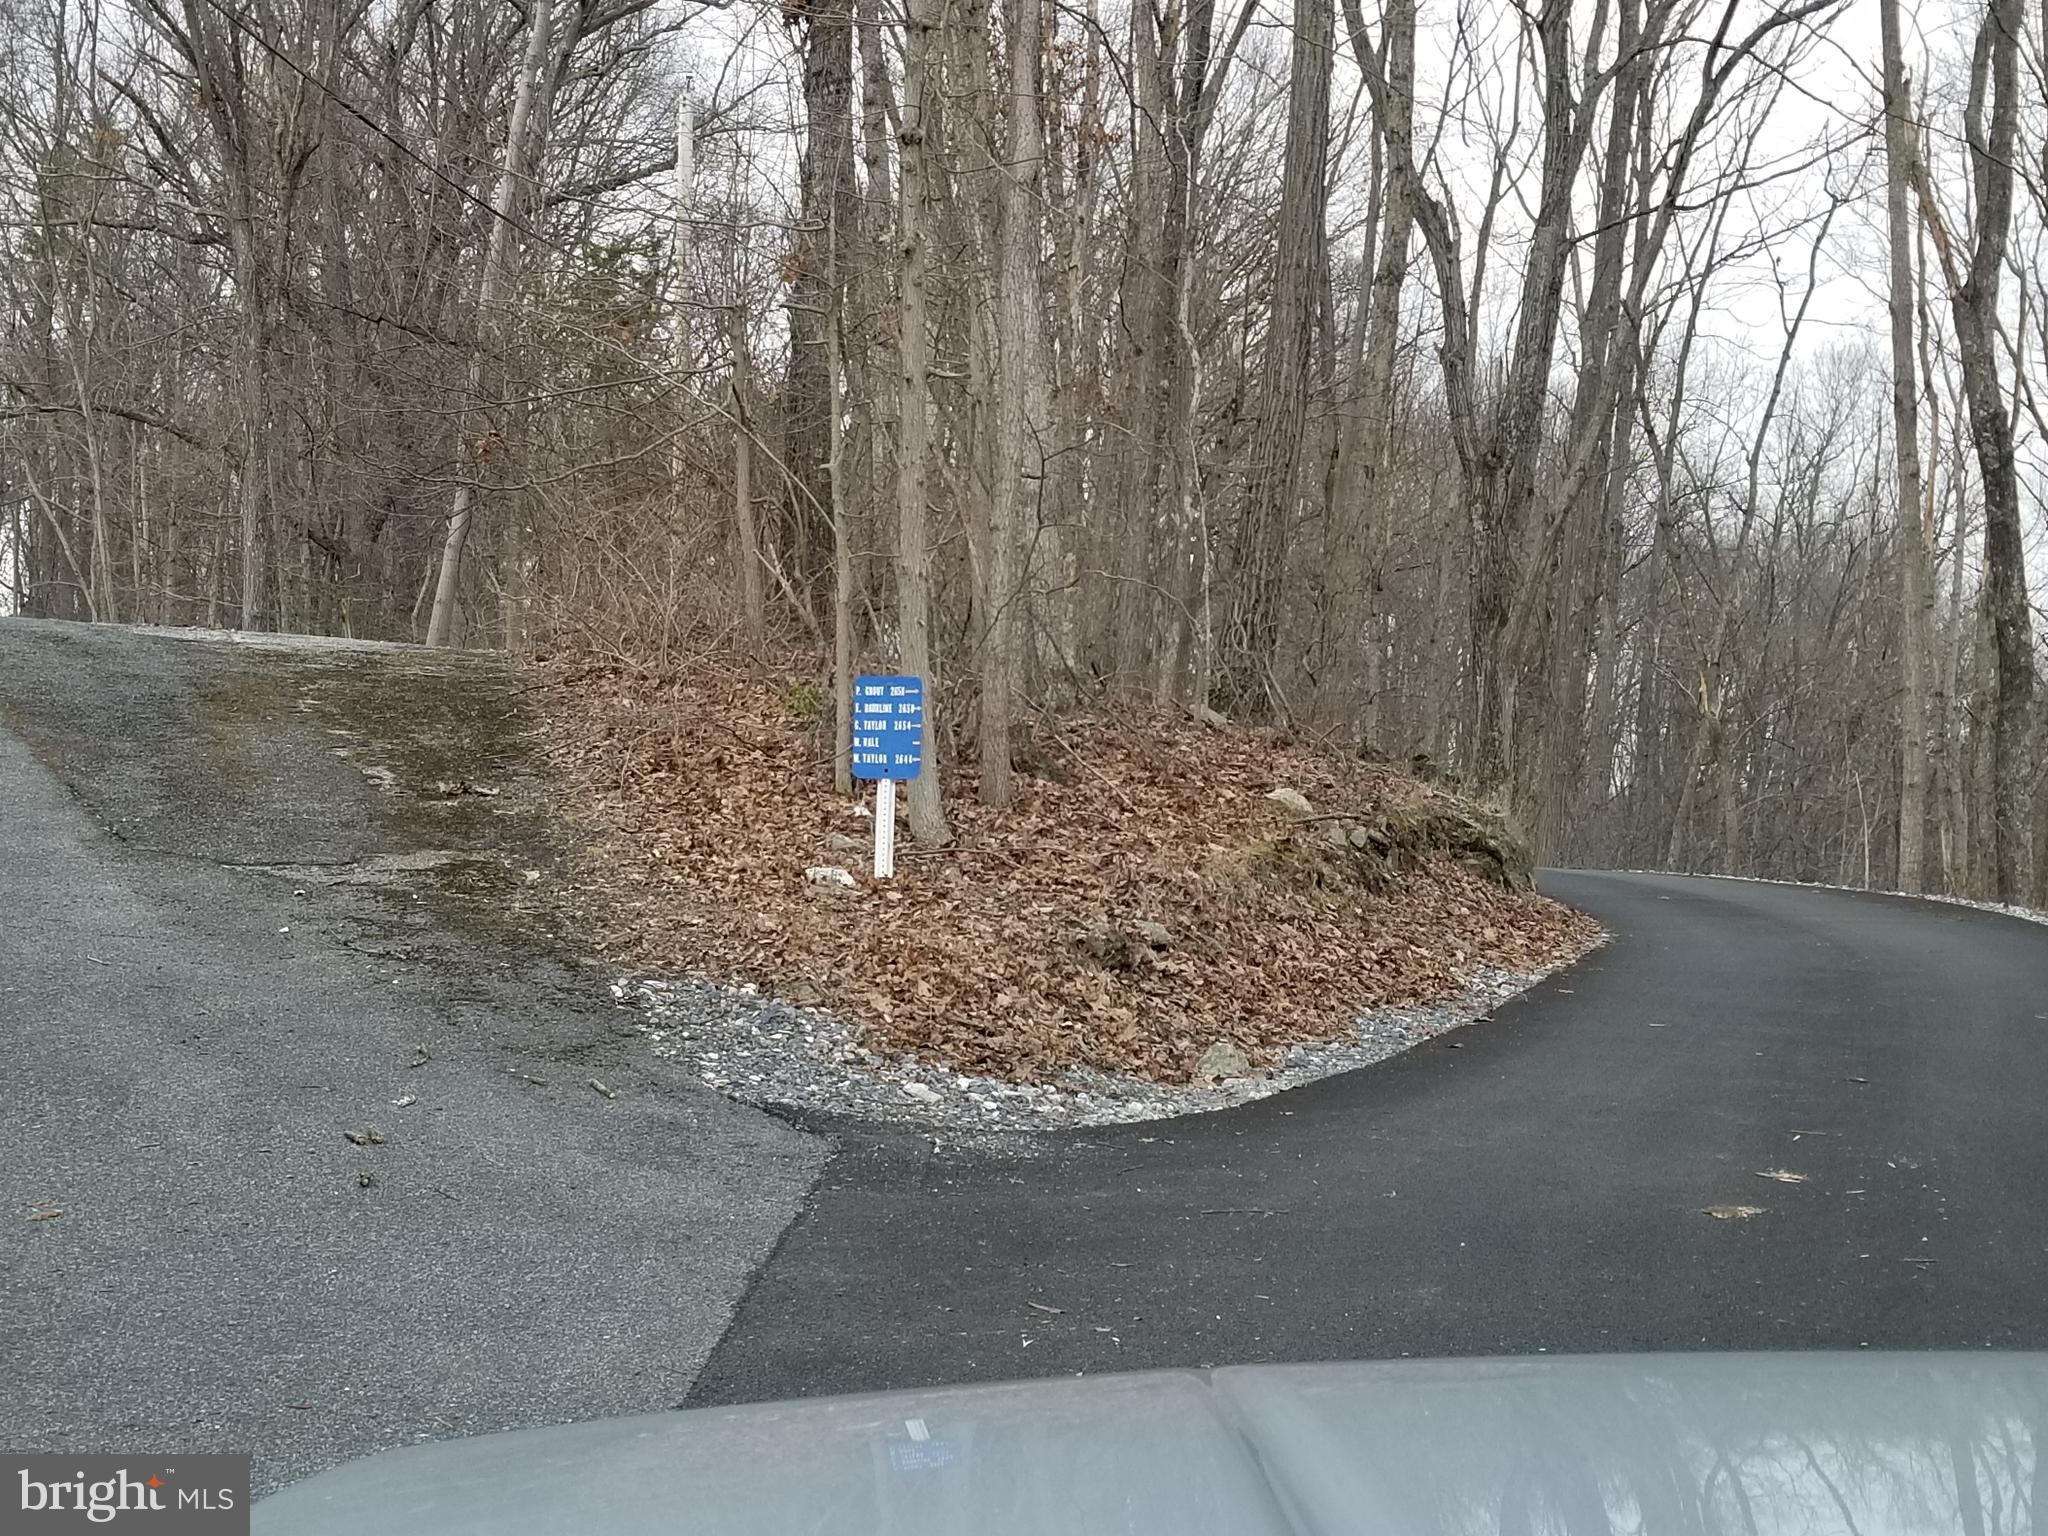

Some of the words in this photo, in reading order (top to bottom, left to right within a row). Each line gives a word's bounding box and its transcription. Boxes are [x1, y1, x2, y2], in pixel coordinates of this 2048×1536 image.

[863, 720, 887, 731] TAYLOR
[894, 720, 911, 731] 2654
[863, 753, 887, 764] TAYLOR
